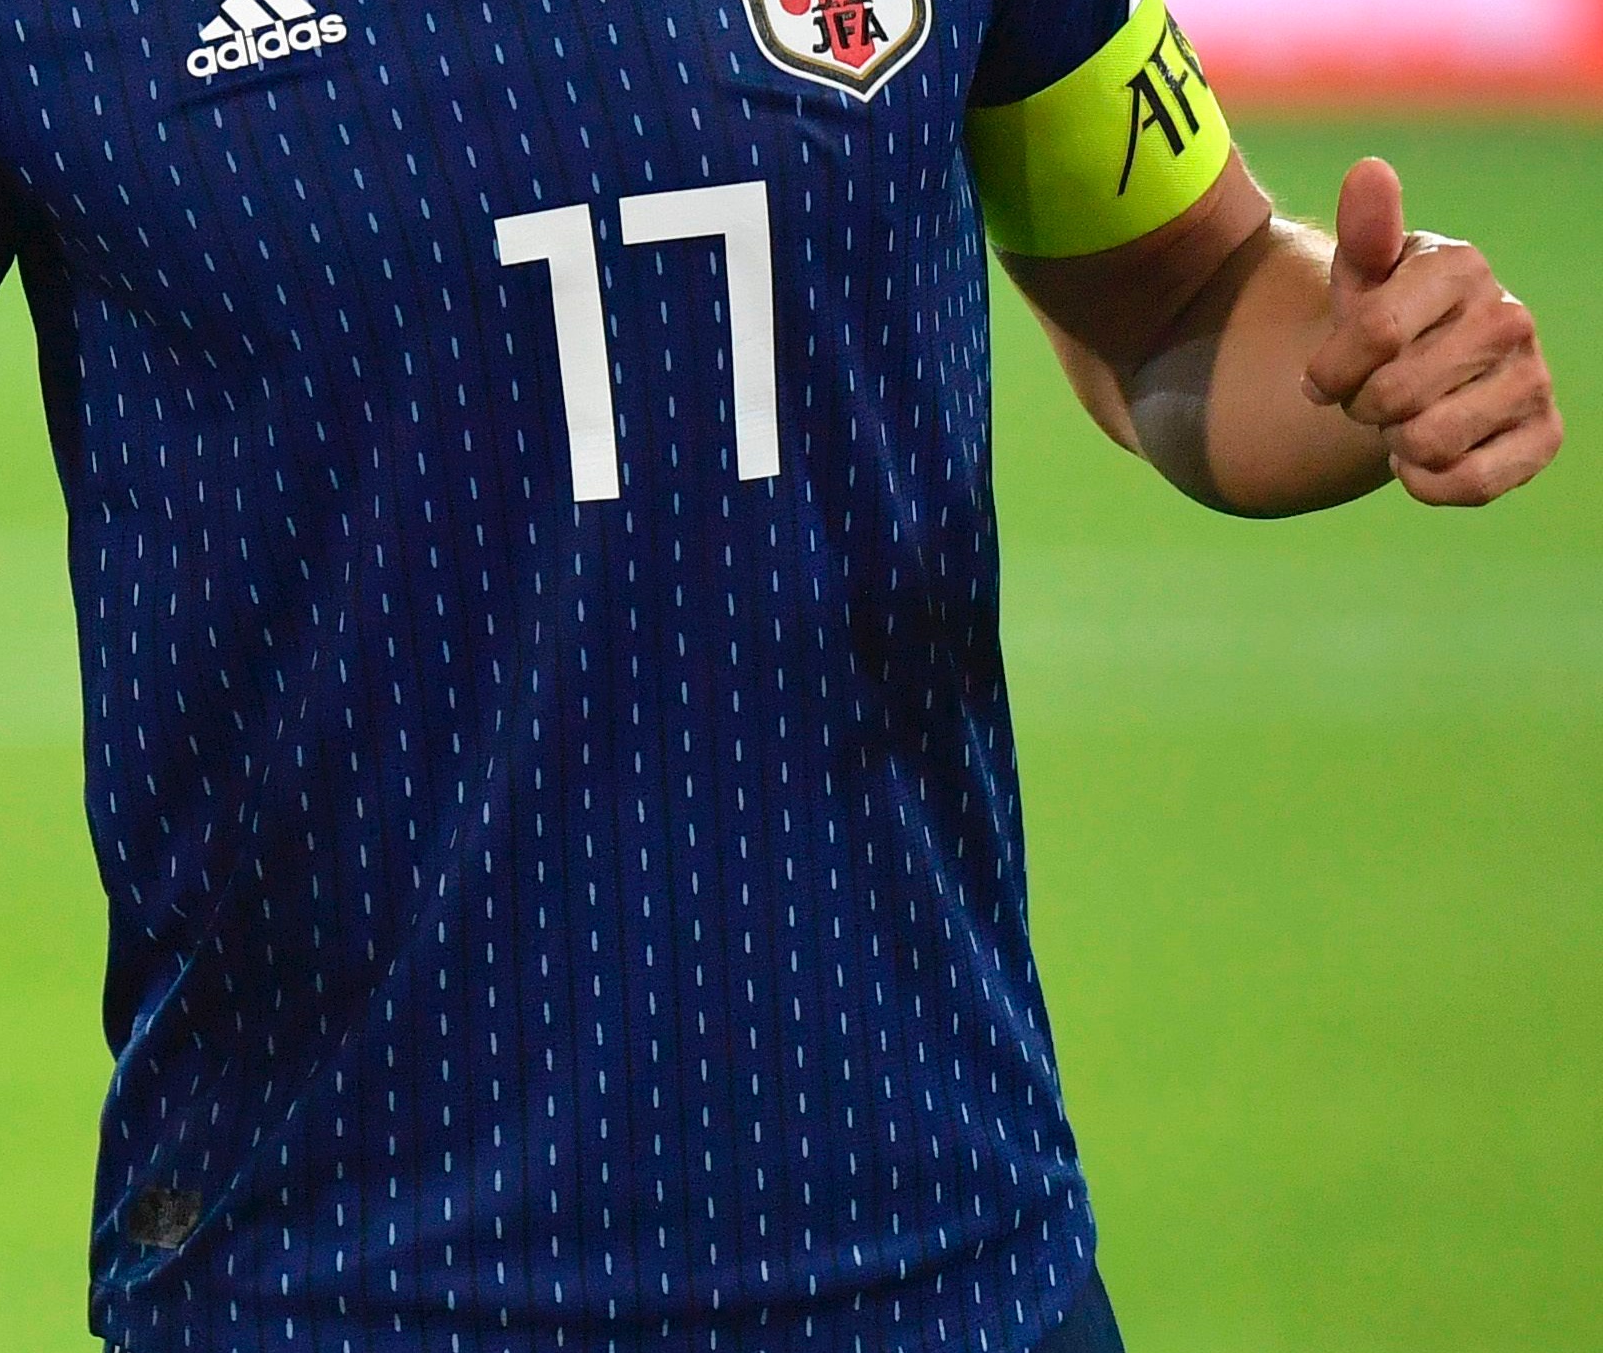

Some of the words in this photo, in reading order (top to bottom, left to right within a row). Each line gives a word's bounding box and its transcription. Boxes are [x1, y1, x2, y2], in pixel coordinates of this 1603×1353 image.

[187, 13, 347, 77] adidas
[812, 7, 889, 53] JFA
[494, 180, 780, 502] 17
